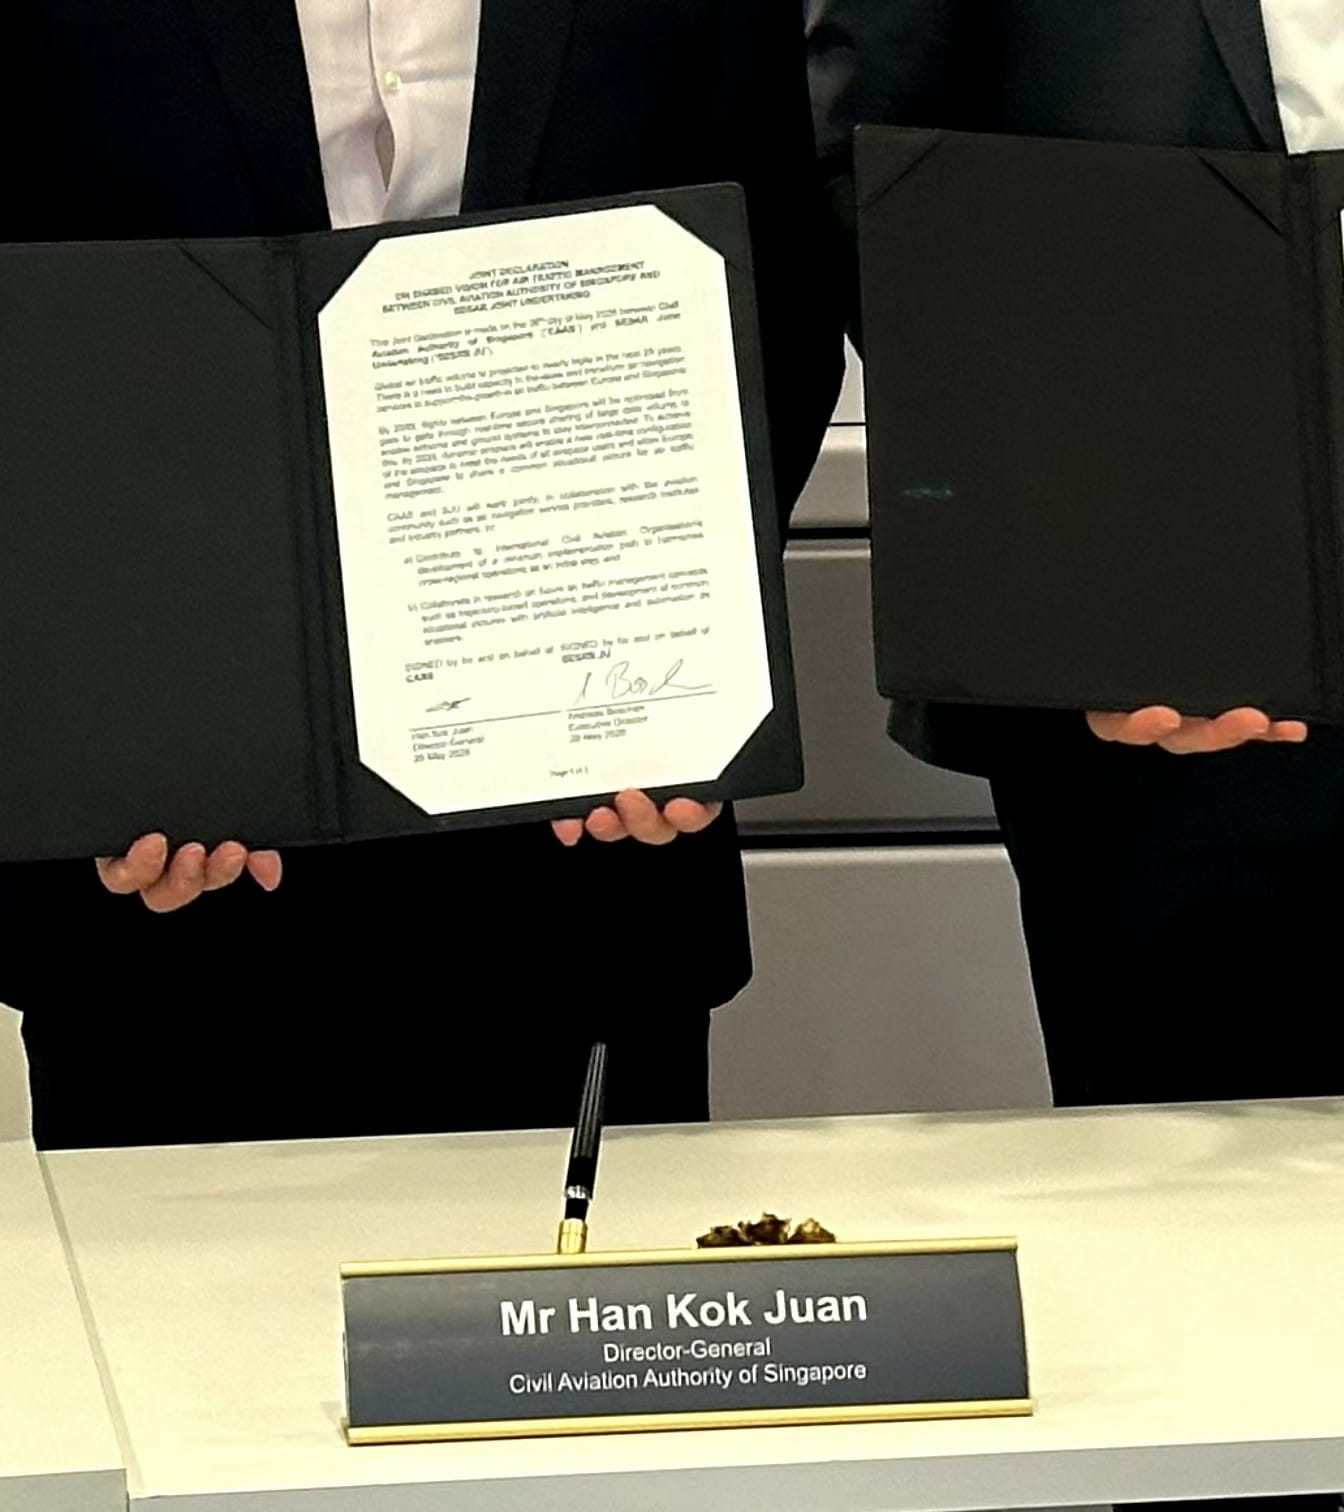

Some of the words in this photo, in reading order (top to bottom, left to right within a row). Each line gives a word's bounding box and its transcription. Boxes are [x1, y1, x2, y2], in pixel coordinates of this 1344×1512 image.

[500, 1300, 555, 1336] Mr
[569, 1297, 652, 1333] Han
[667, 1292, 752, 1329] Kok
[764, 1289, 868, 1324] Juan
[603, 1337, 773, 1364] Director-General
[509, 1372, 554, 1395] Civil
[557, 1368, 639, 1393] Aviation
[643, 1366, 734, 1392] Authority
[738, 1364, 759, 1385] of
[763, 1362, 868, 1387] Singapore
